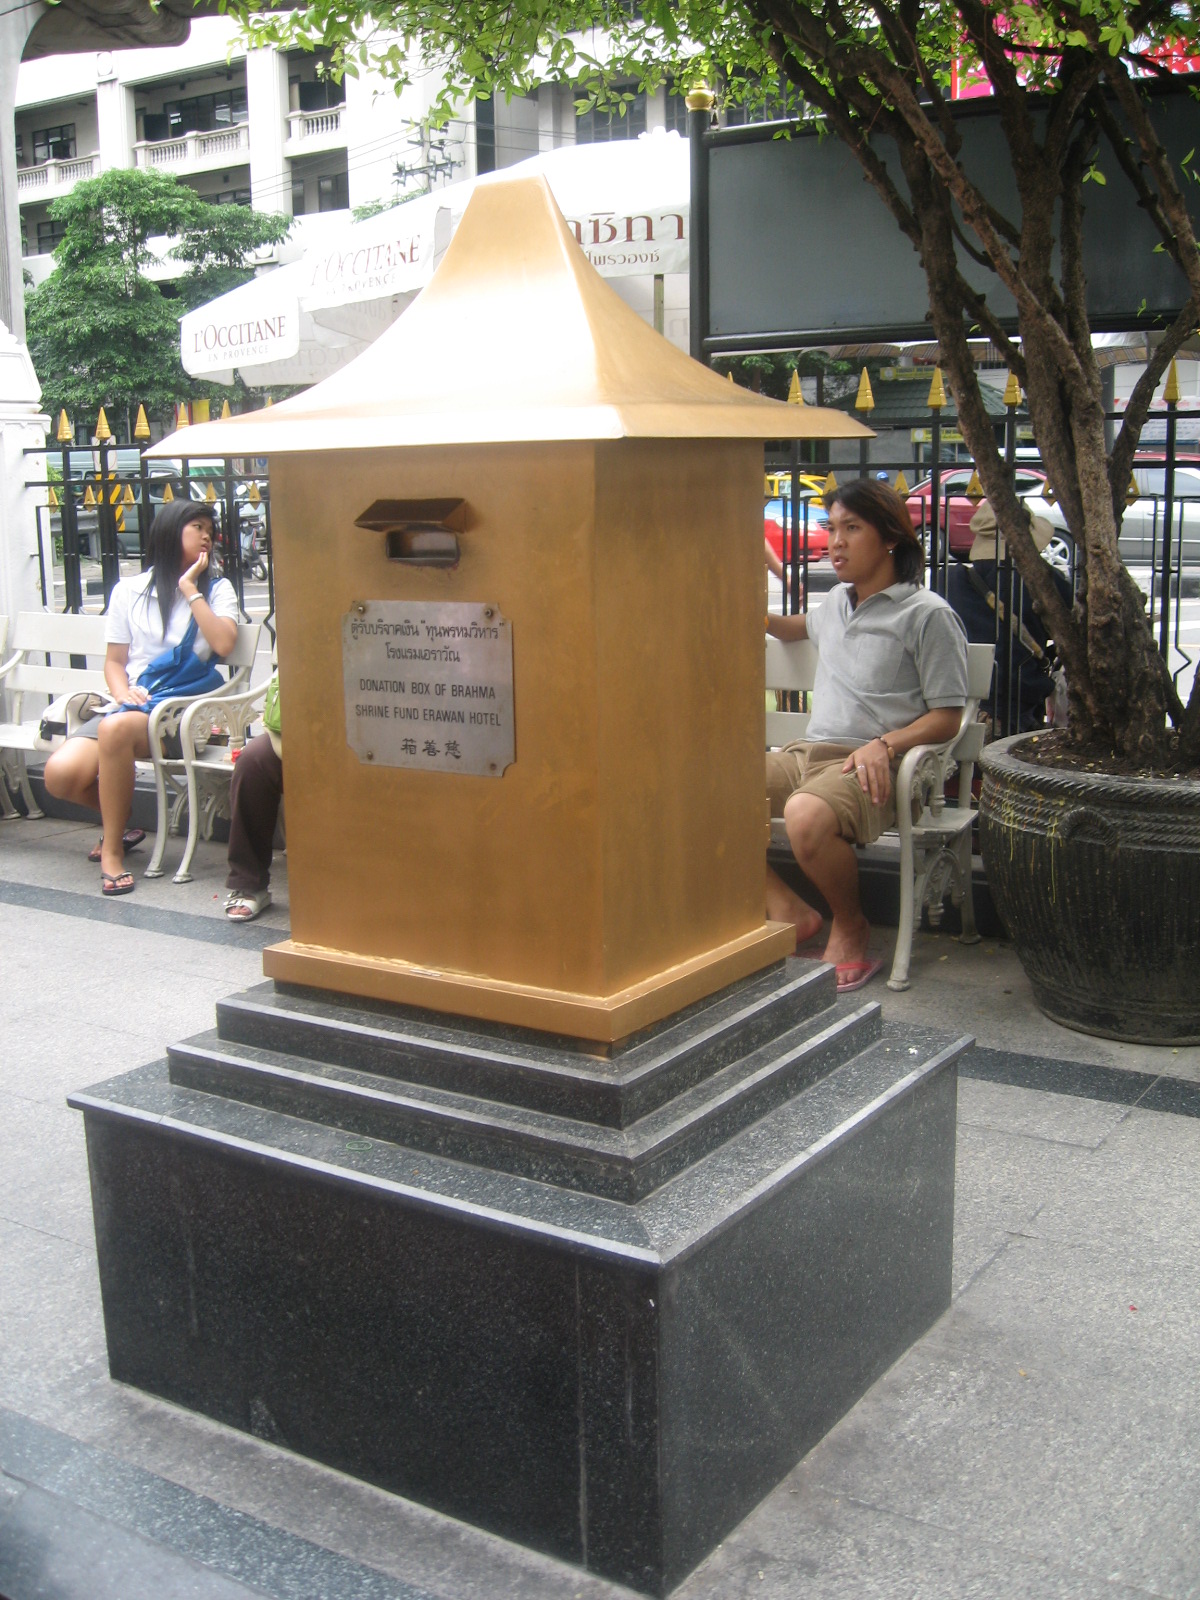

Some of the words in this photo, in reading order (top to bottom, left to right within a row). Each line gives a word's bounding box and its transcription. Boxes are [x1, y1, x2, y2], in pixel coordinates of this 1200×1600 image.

[194, 315, 287, 353] L'OCCITANE
[223, 344, 269, 360] PROVENCE
[386, 642, 461, 662] โรงแรมเอราวัณ
[359, 678, 405, 694] DONATION
[411, 682, 430, 695] BOX
[435, 683, 447, 696] OF
[451, 684, 496, 700] BRAHMA
[355, 704, 390, 719] SHRINE
[393, 706, 419, 720] FUND
[423, 708, 465, 724] ERAWAN
[469, 711, 502, 727] HOTEL
